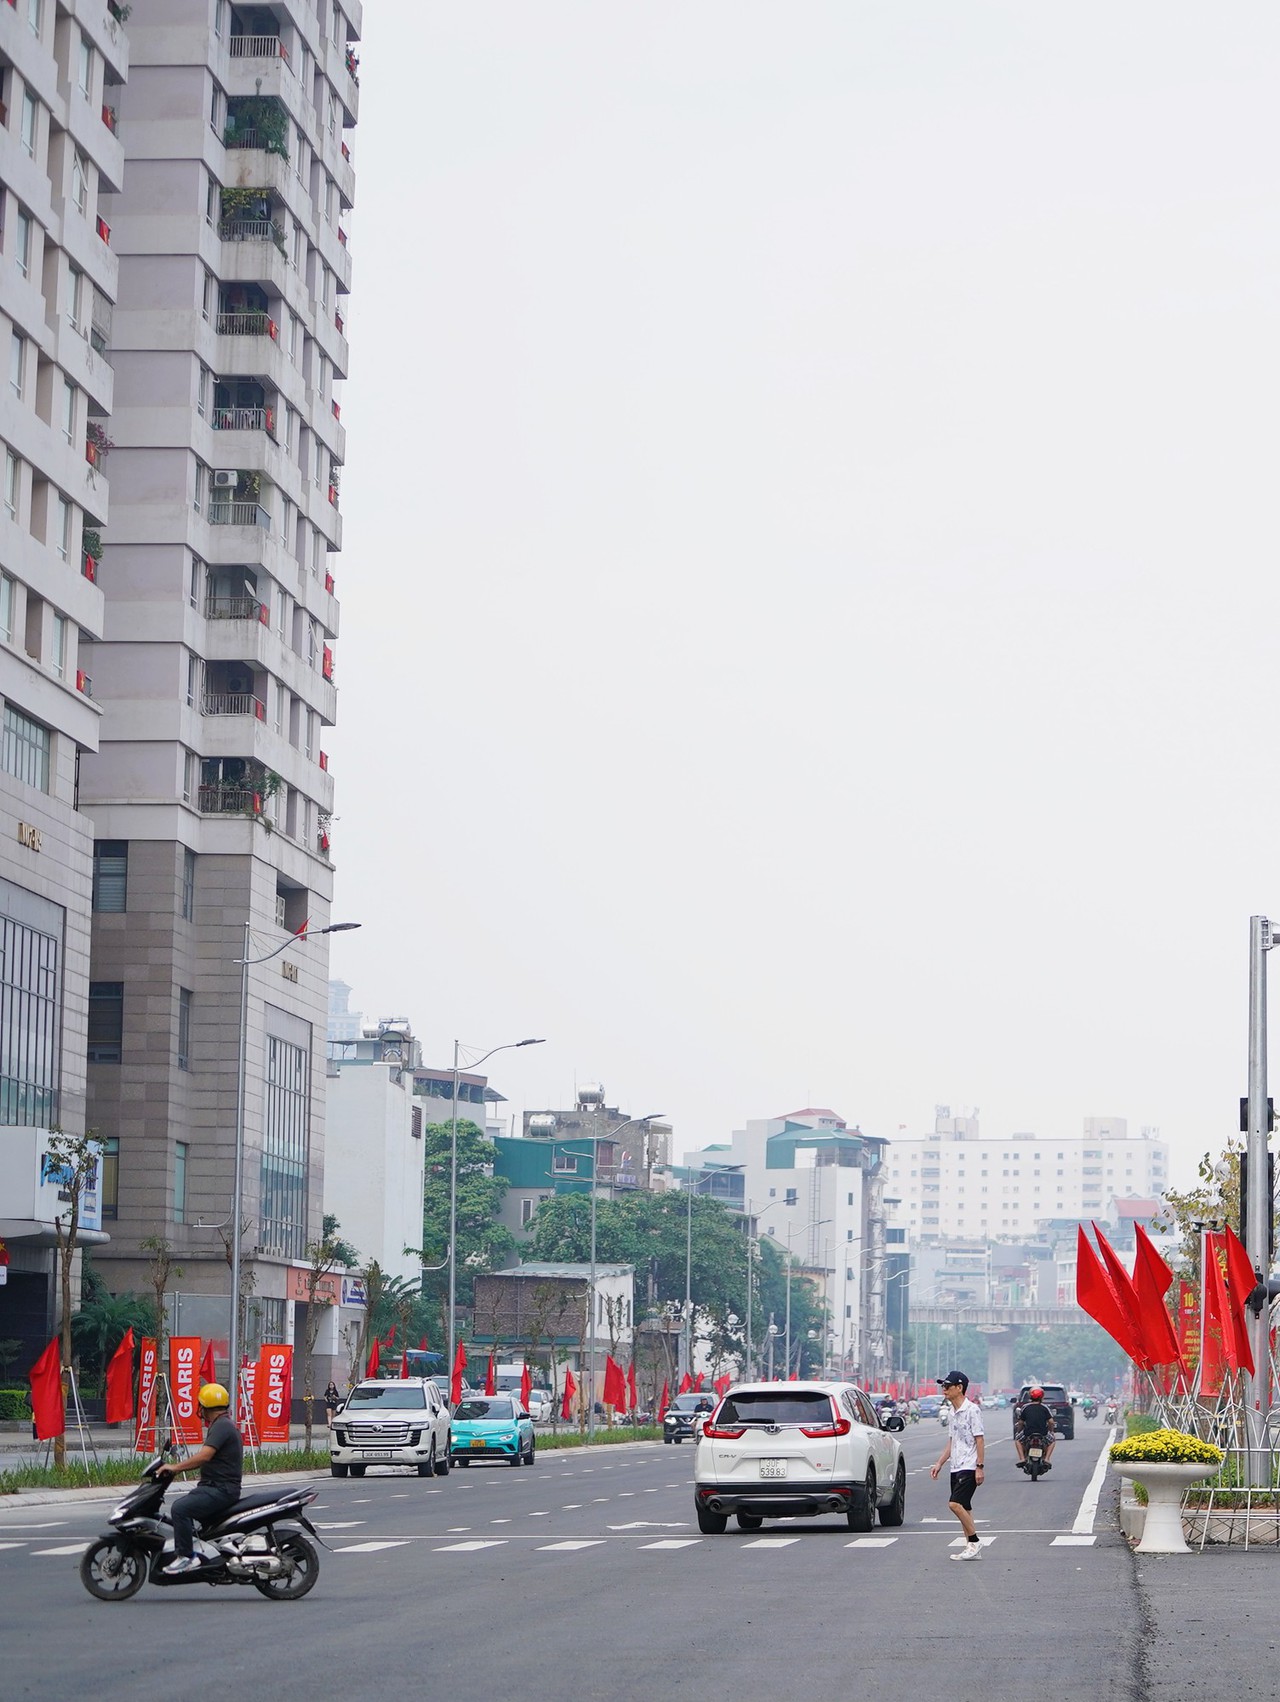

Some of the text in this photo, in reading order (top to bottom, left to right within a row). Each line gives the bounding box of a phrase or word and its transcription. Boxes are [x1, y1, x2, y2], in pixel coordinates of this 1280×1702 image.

[141, 1350, 154, 1424] GARIS
[178, 1347, 193, 1418] GARIS
[267, 1354, 285, 1418] GARIS
